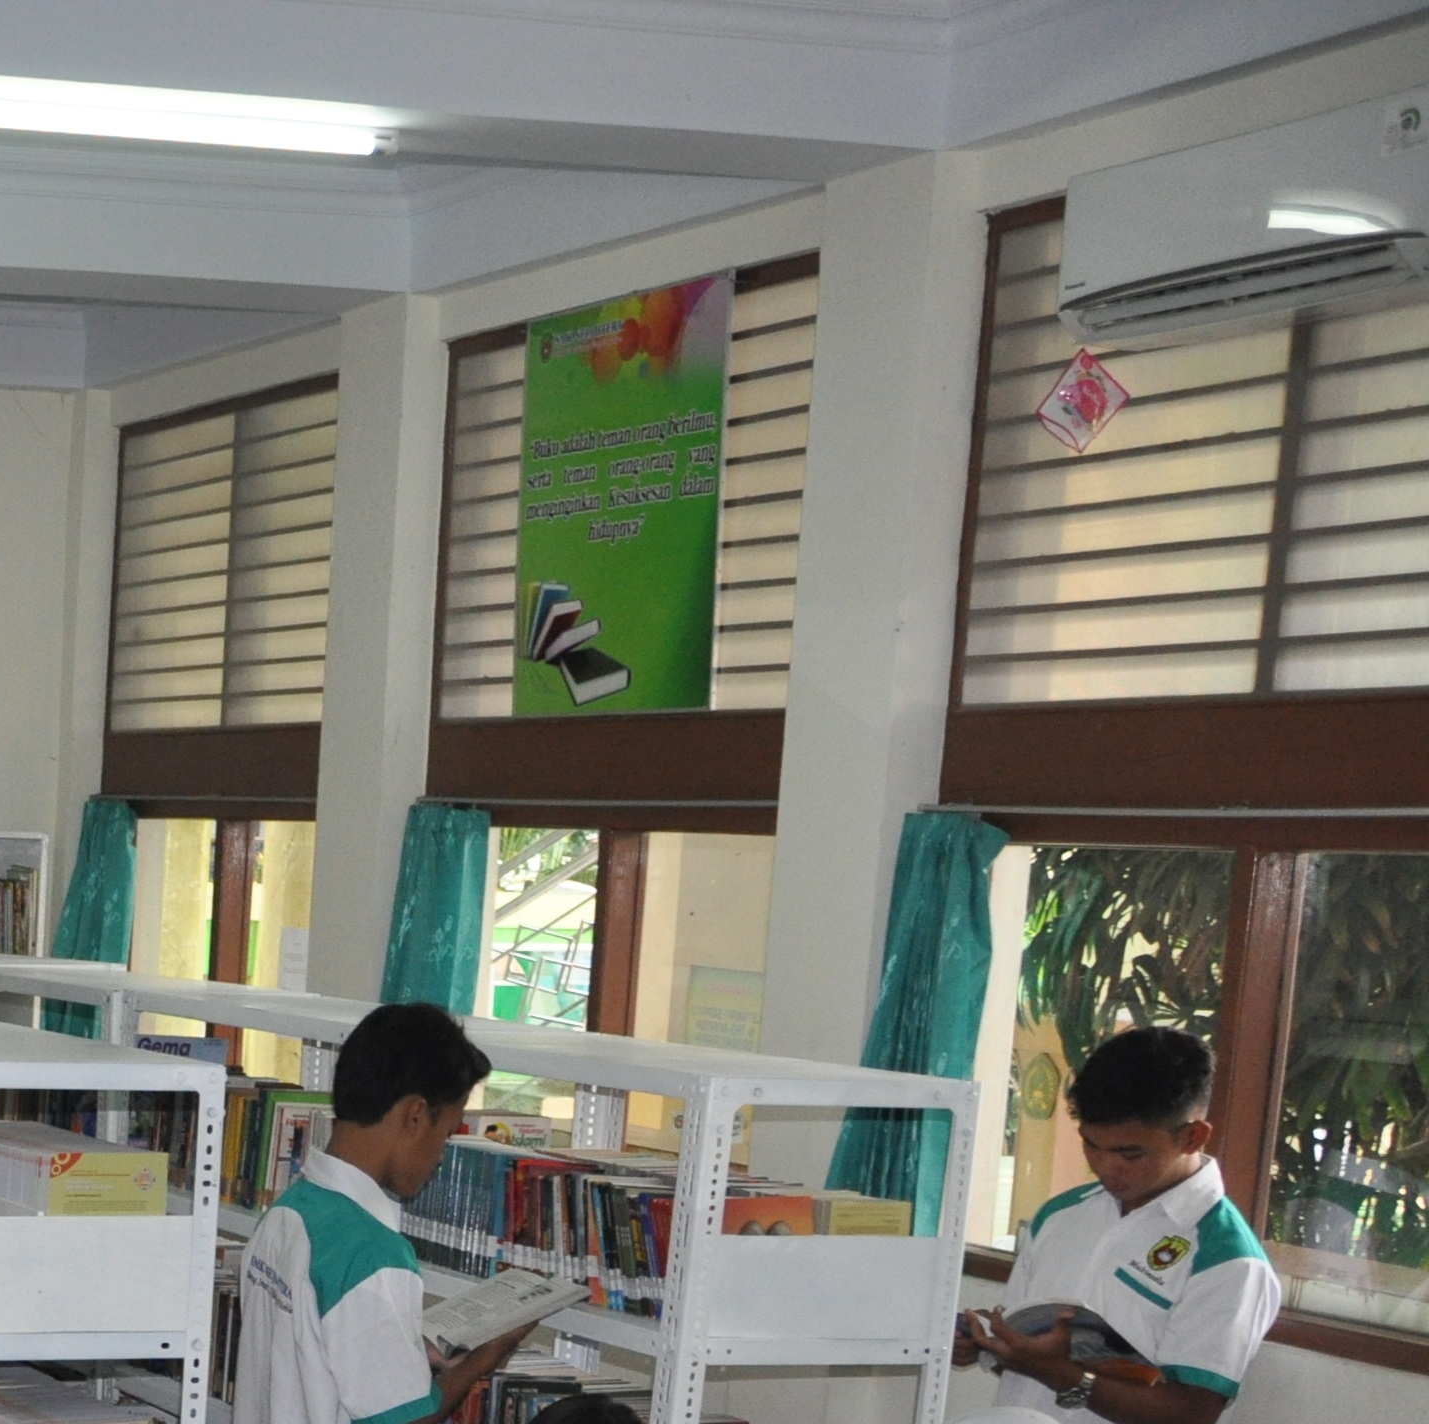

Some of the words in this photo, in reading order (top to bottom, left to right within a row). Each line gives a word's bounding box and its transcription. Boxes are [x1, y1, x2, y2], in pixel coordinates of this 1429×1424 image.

[561, 429, 596, 455] adalah
[598, 429, 631, 449] teman
[635, 422, 666, 444] orang
[528, 471, 552, 489] serta
[564, 465, 596, 484] teman
[608, 451, 675, 478] orang-orang
[688, 445, 716, 474] yang
[526, 490, 600, 523] menginginkan
[608, 482, 672, 509] Kesuksesan
[680, 476, 714, 499] dalam
[137, 1037, 192, 1057] Gema
